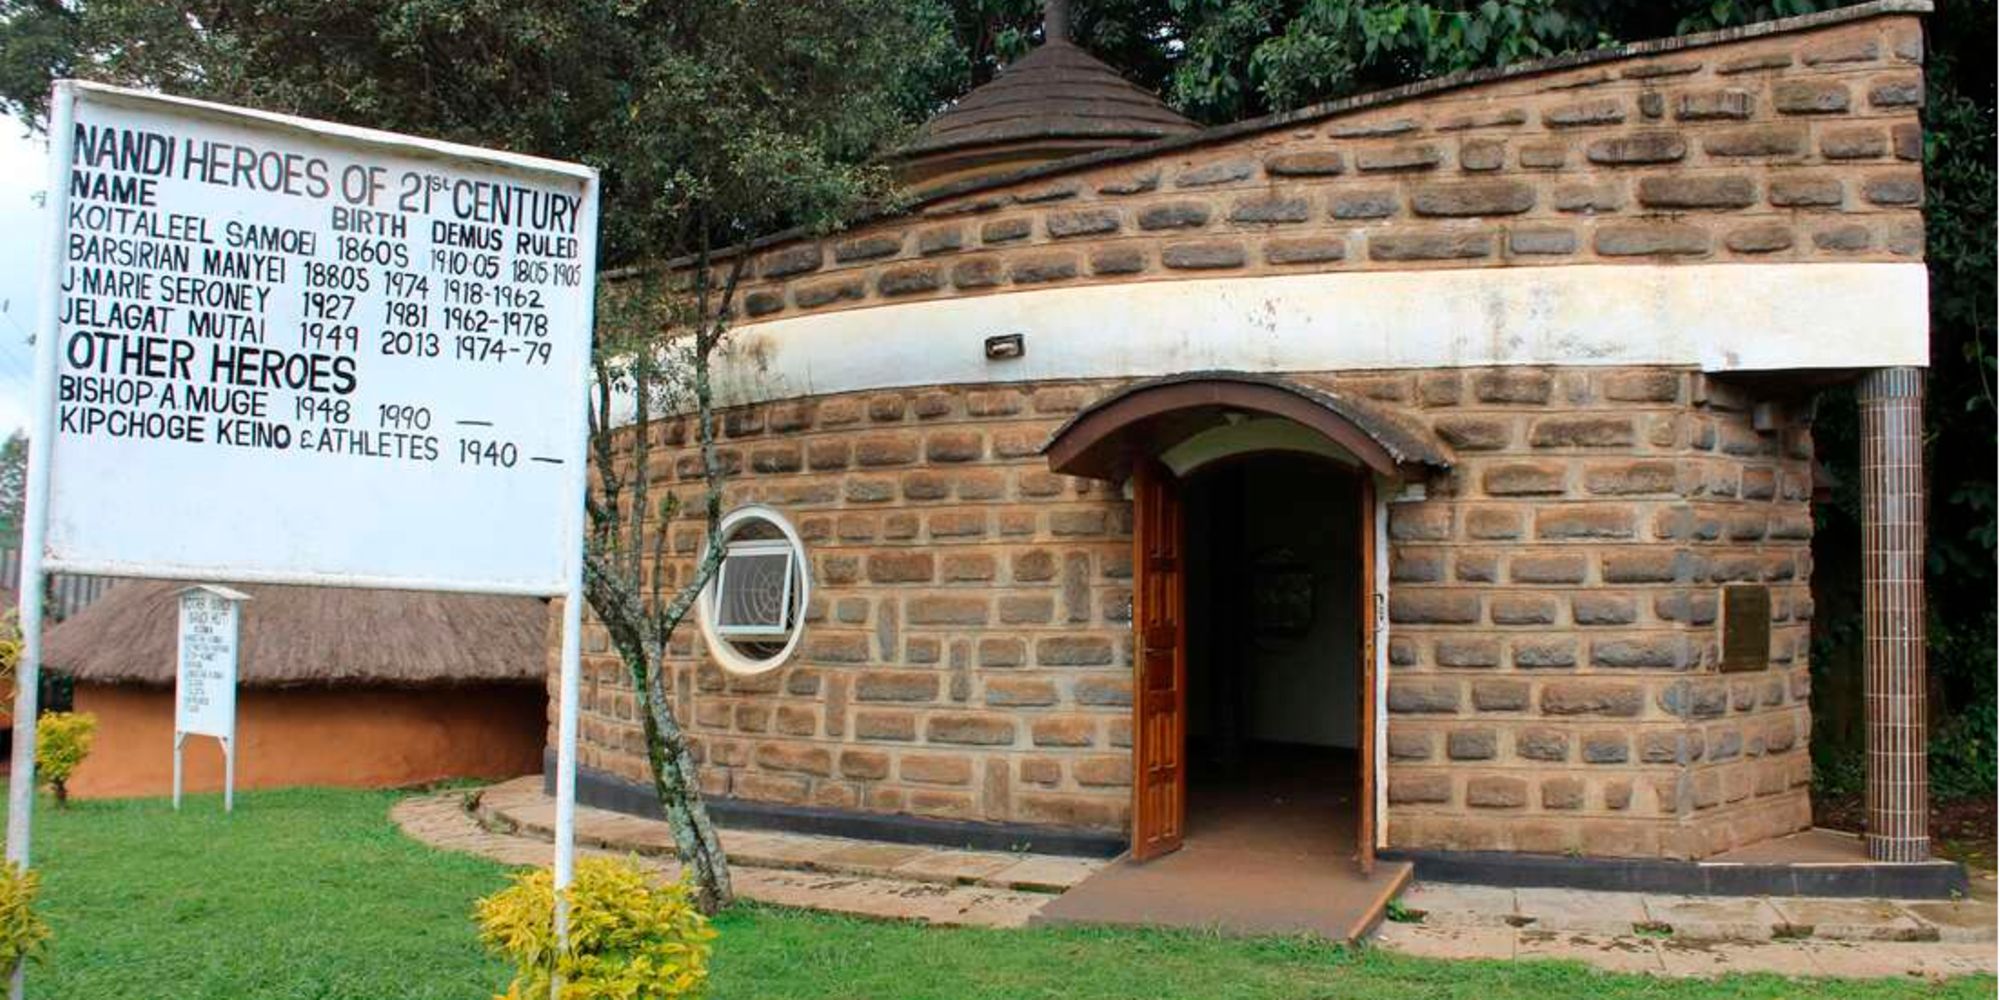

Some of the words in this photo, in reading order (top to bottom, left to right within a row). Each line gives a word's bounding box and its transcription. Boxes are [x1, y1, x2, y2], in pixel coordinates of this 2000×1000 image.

[72, 123, 176, 177] NANDI
[183, 138, 330, 199] HEROES
[341, 164, 388, 206] OF
[452, 179, 582, 234] CENTURY
[69, 202, 214, 244] KOITALEEL
[226, 220, 317, 257] SAMOEI
[70, 171, 158, 207] NAME
[332, 206, 407, 239] BIRTH
[432, 220, 503, 251] DEMUS
[517, 232, 578, 259] RULED
[68, 233, 189, 273] BARSIRIAN
[203, 249, 286, 283] MANYEI
[384, 271, 429, 299] 1974
[444, 279, 545, 308] 1918-1962
[59, 297, 175, 334] JELAGAT
[188, 310, 265, 344] MUTAI
[300, 322, 358, 352] 1949
[380, 331, 440, 357] 2013
[456, 335, 552, 365] 1974-79
[160, 275, 270, 313] SERONEY
[303, 292, 355, 321] 1927
[385, 301, 428, 328] 1981
[444, 307, 549, 337] 1962-1978
[67, 330, 195, 381] OTHER
[210, 344, 357, 395] HEROES
[60, 405, 205, 442] KIPCHOGE
[216, 419, 291, 449] KEINO
[459, 438, 518, 468] 1940
[295, 396, 351, 424] 1948
[379, 404, 431, 430] 1990
